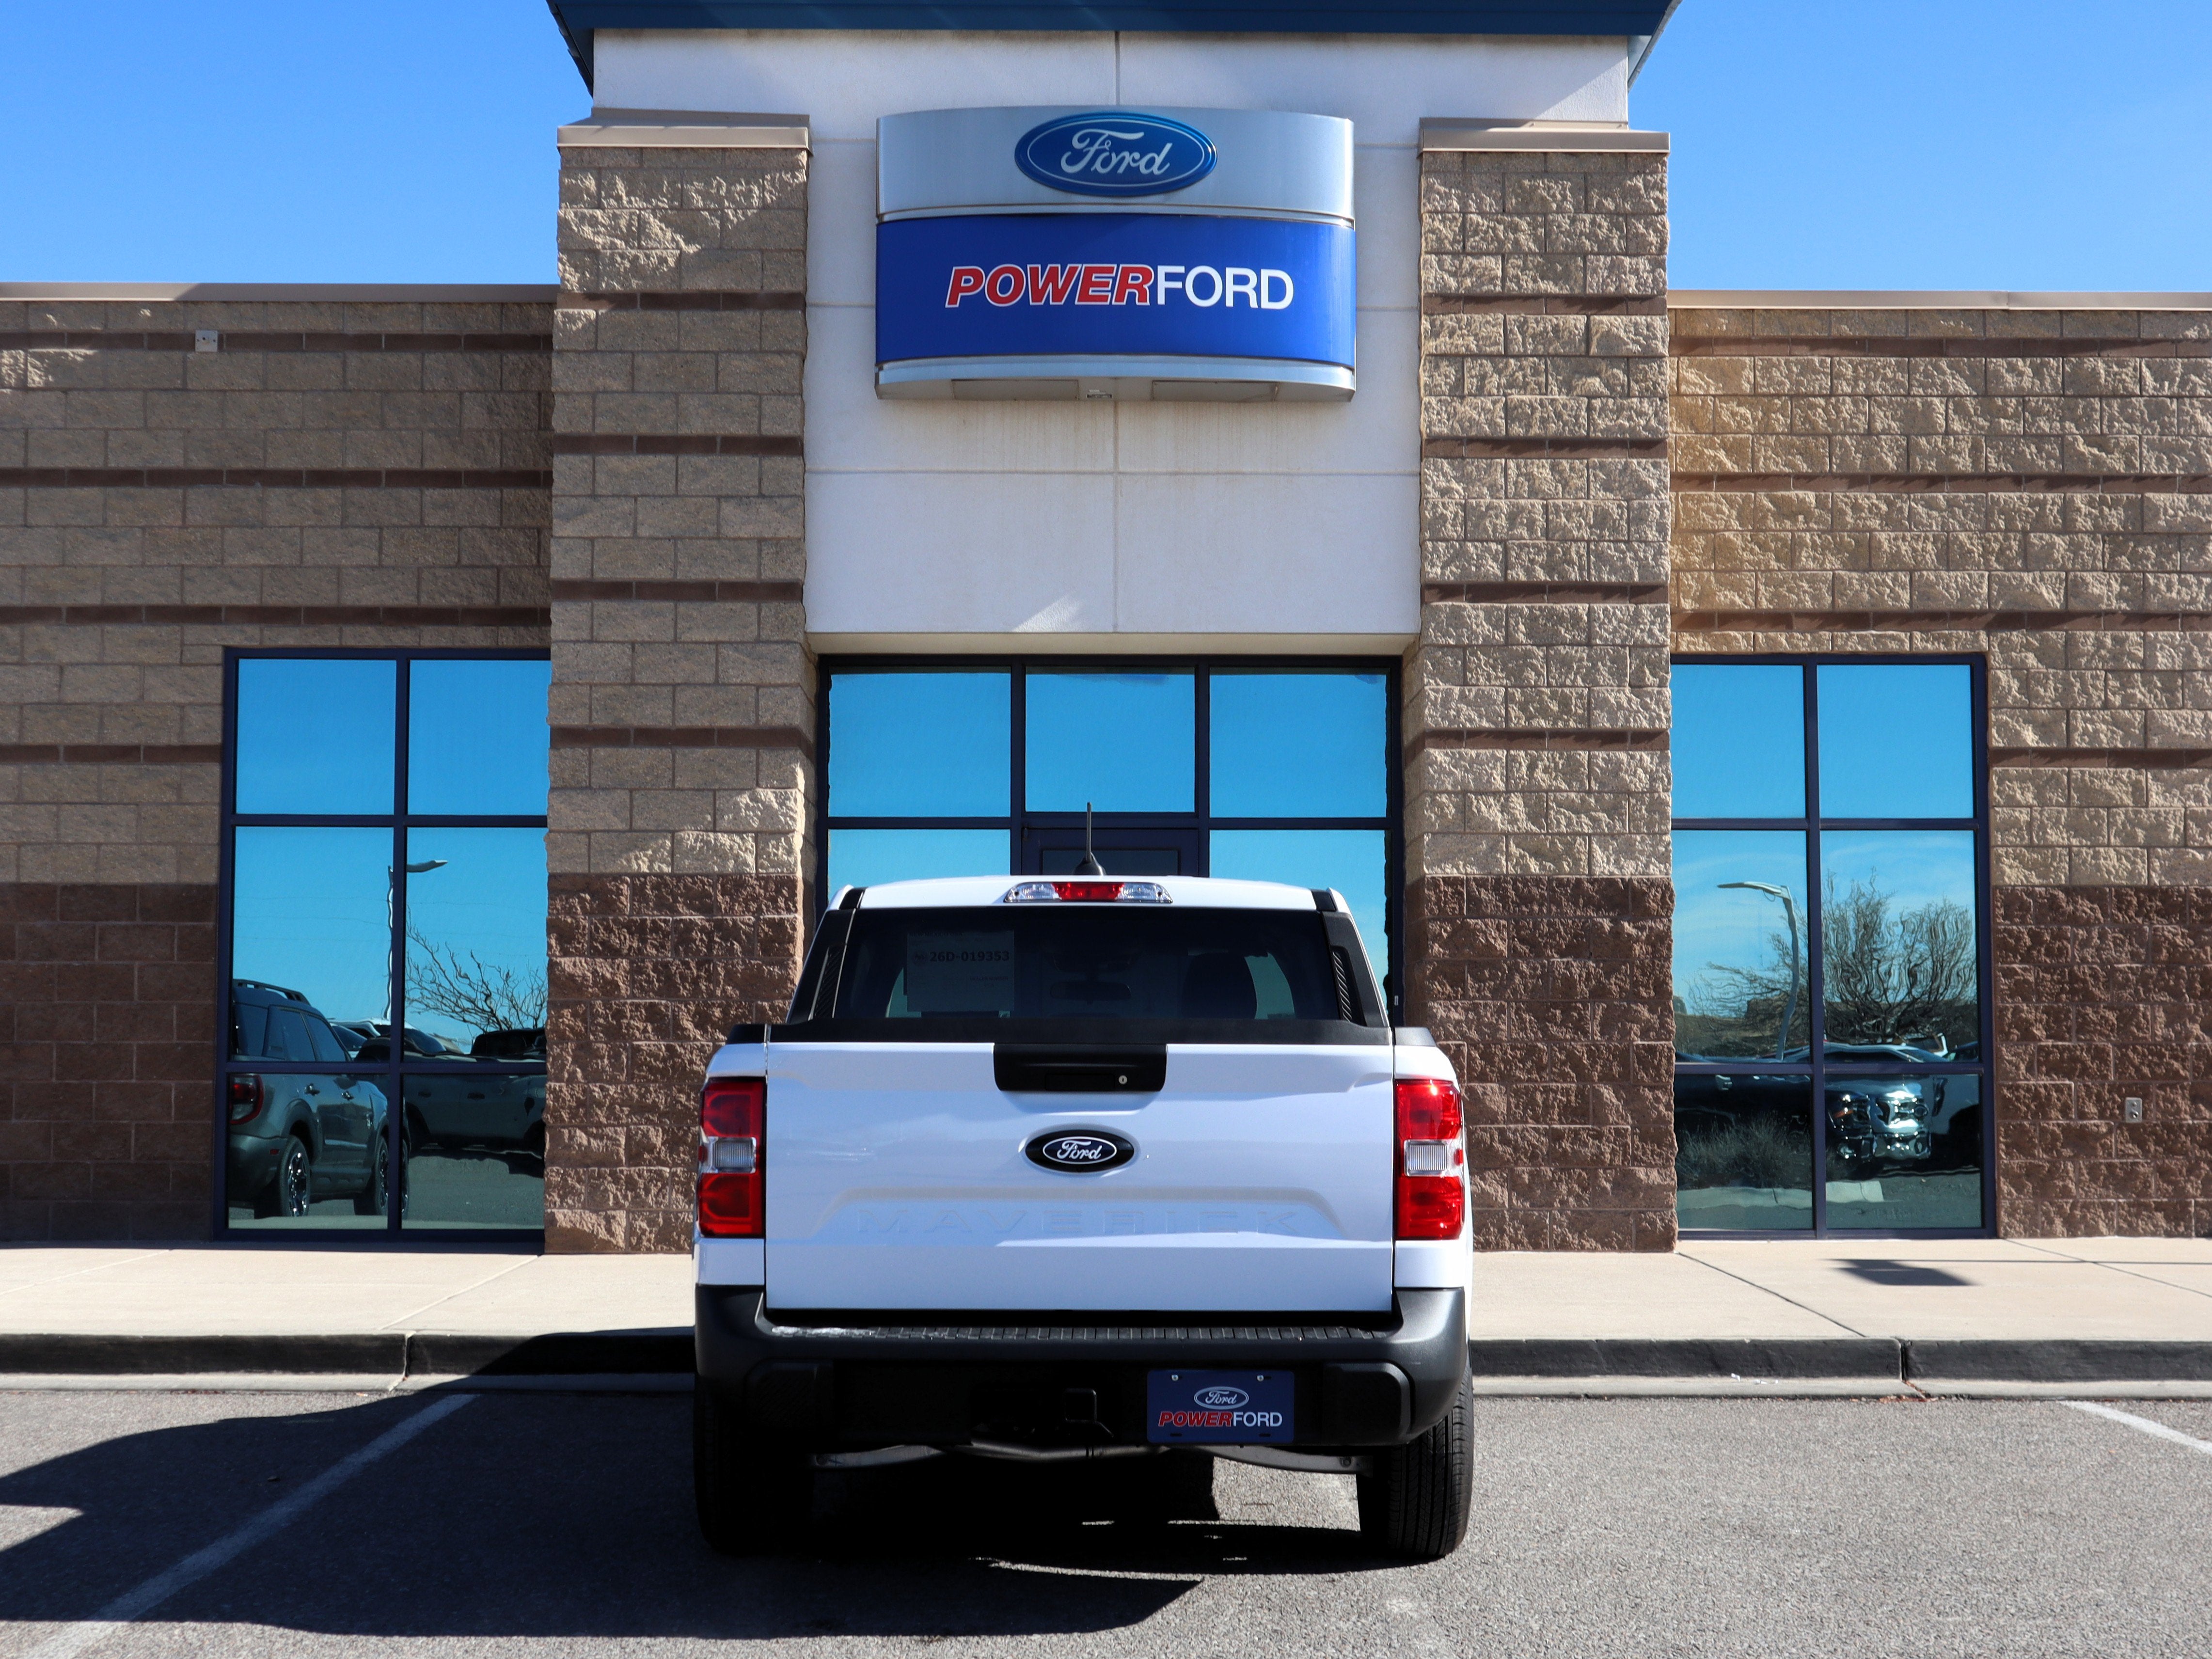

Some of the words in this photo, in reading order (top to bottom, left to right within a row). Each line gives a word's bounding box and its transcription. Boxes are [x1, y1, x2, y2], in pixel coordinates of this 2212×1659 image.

[1060, 127, 1172, 176] Ford
[930, 951, 1010, 962] 26D-019353
[1057, 1140, 1103, 1160] Ford
[858, 1210, 1301, 1234] MAVERICK
[1205, 1390, 1238, 1405] Ford
